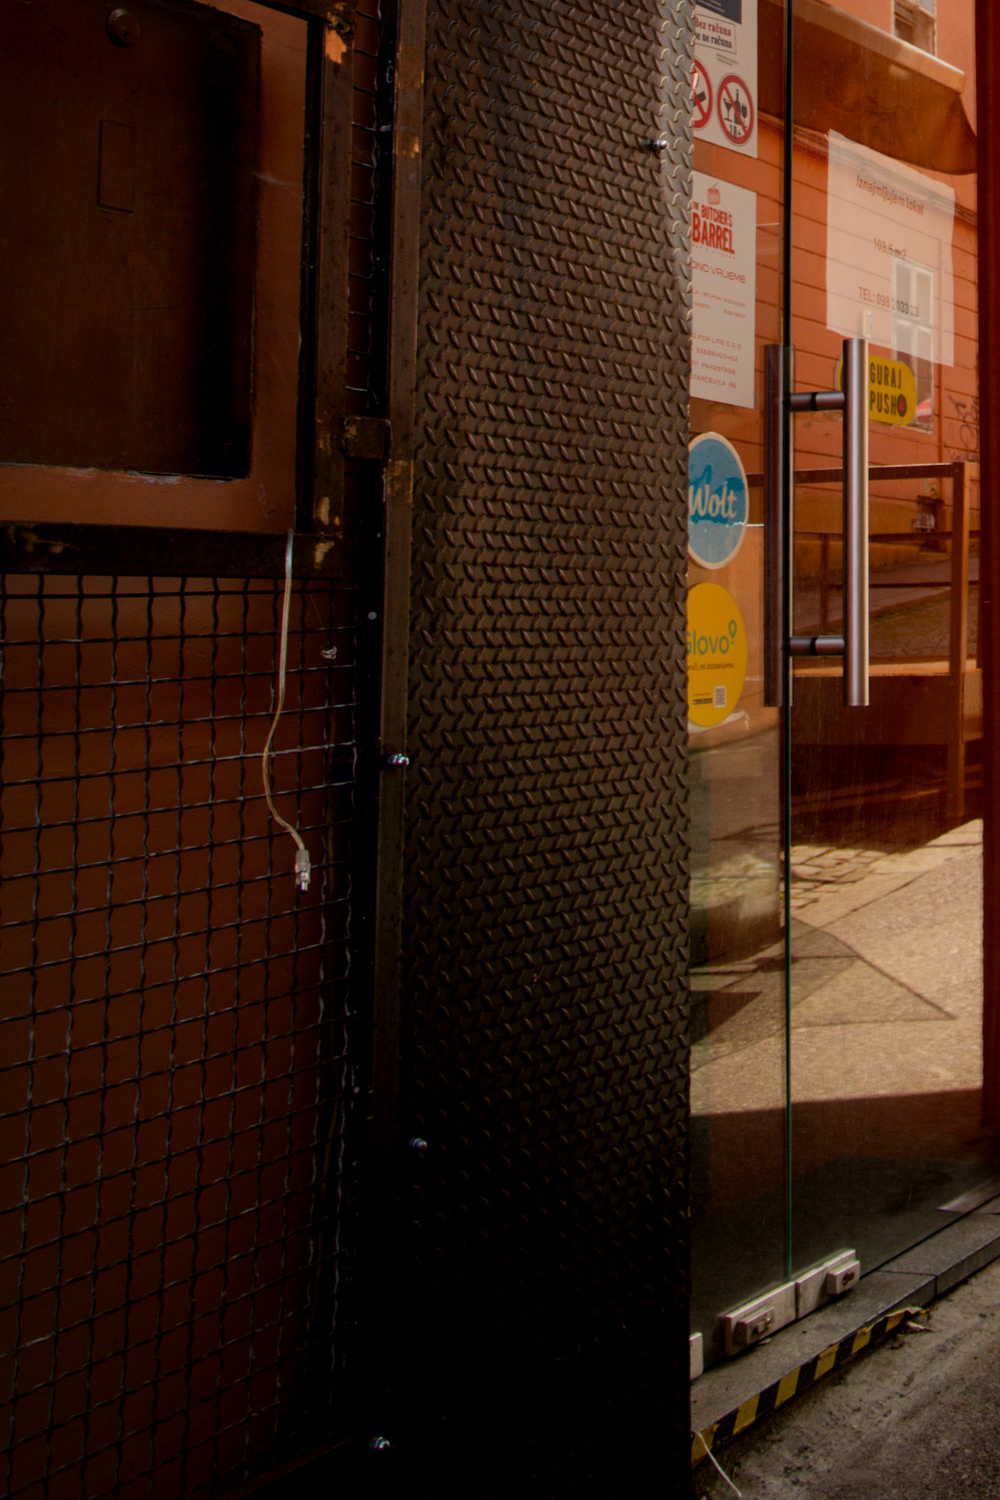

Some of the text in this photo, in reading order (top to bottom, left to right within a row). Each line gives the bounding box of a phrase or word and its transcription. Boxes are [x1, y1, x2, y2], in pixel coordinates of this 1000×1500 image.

[692, 212, 735, 255] BARREL
[869, 362, 902, 389] GURAJ
[869, 389, 897, 416] PUSH
[688, 483, 738, 520] Wolt
